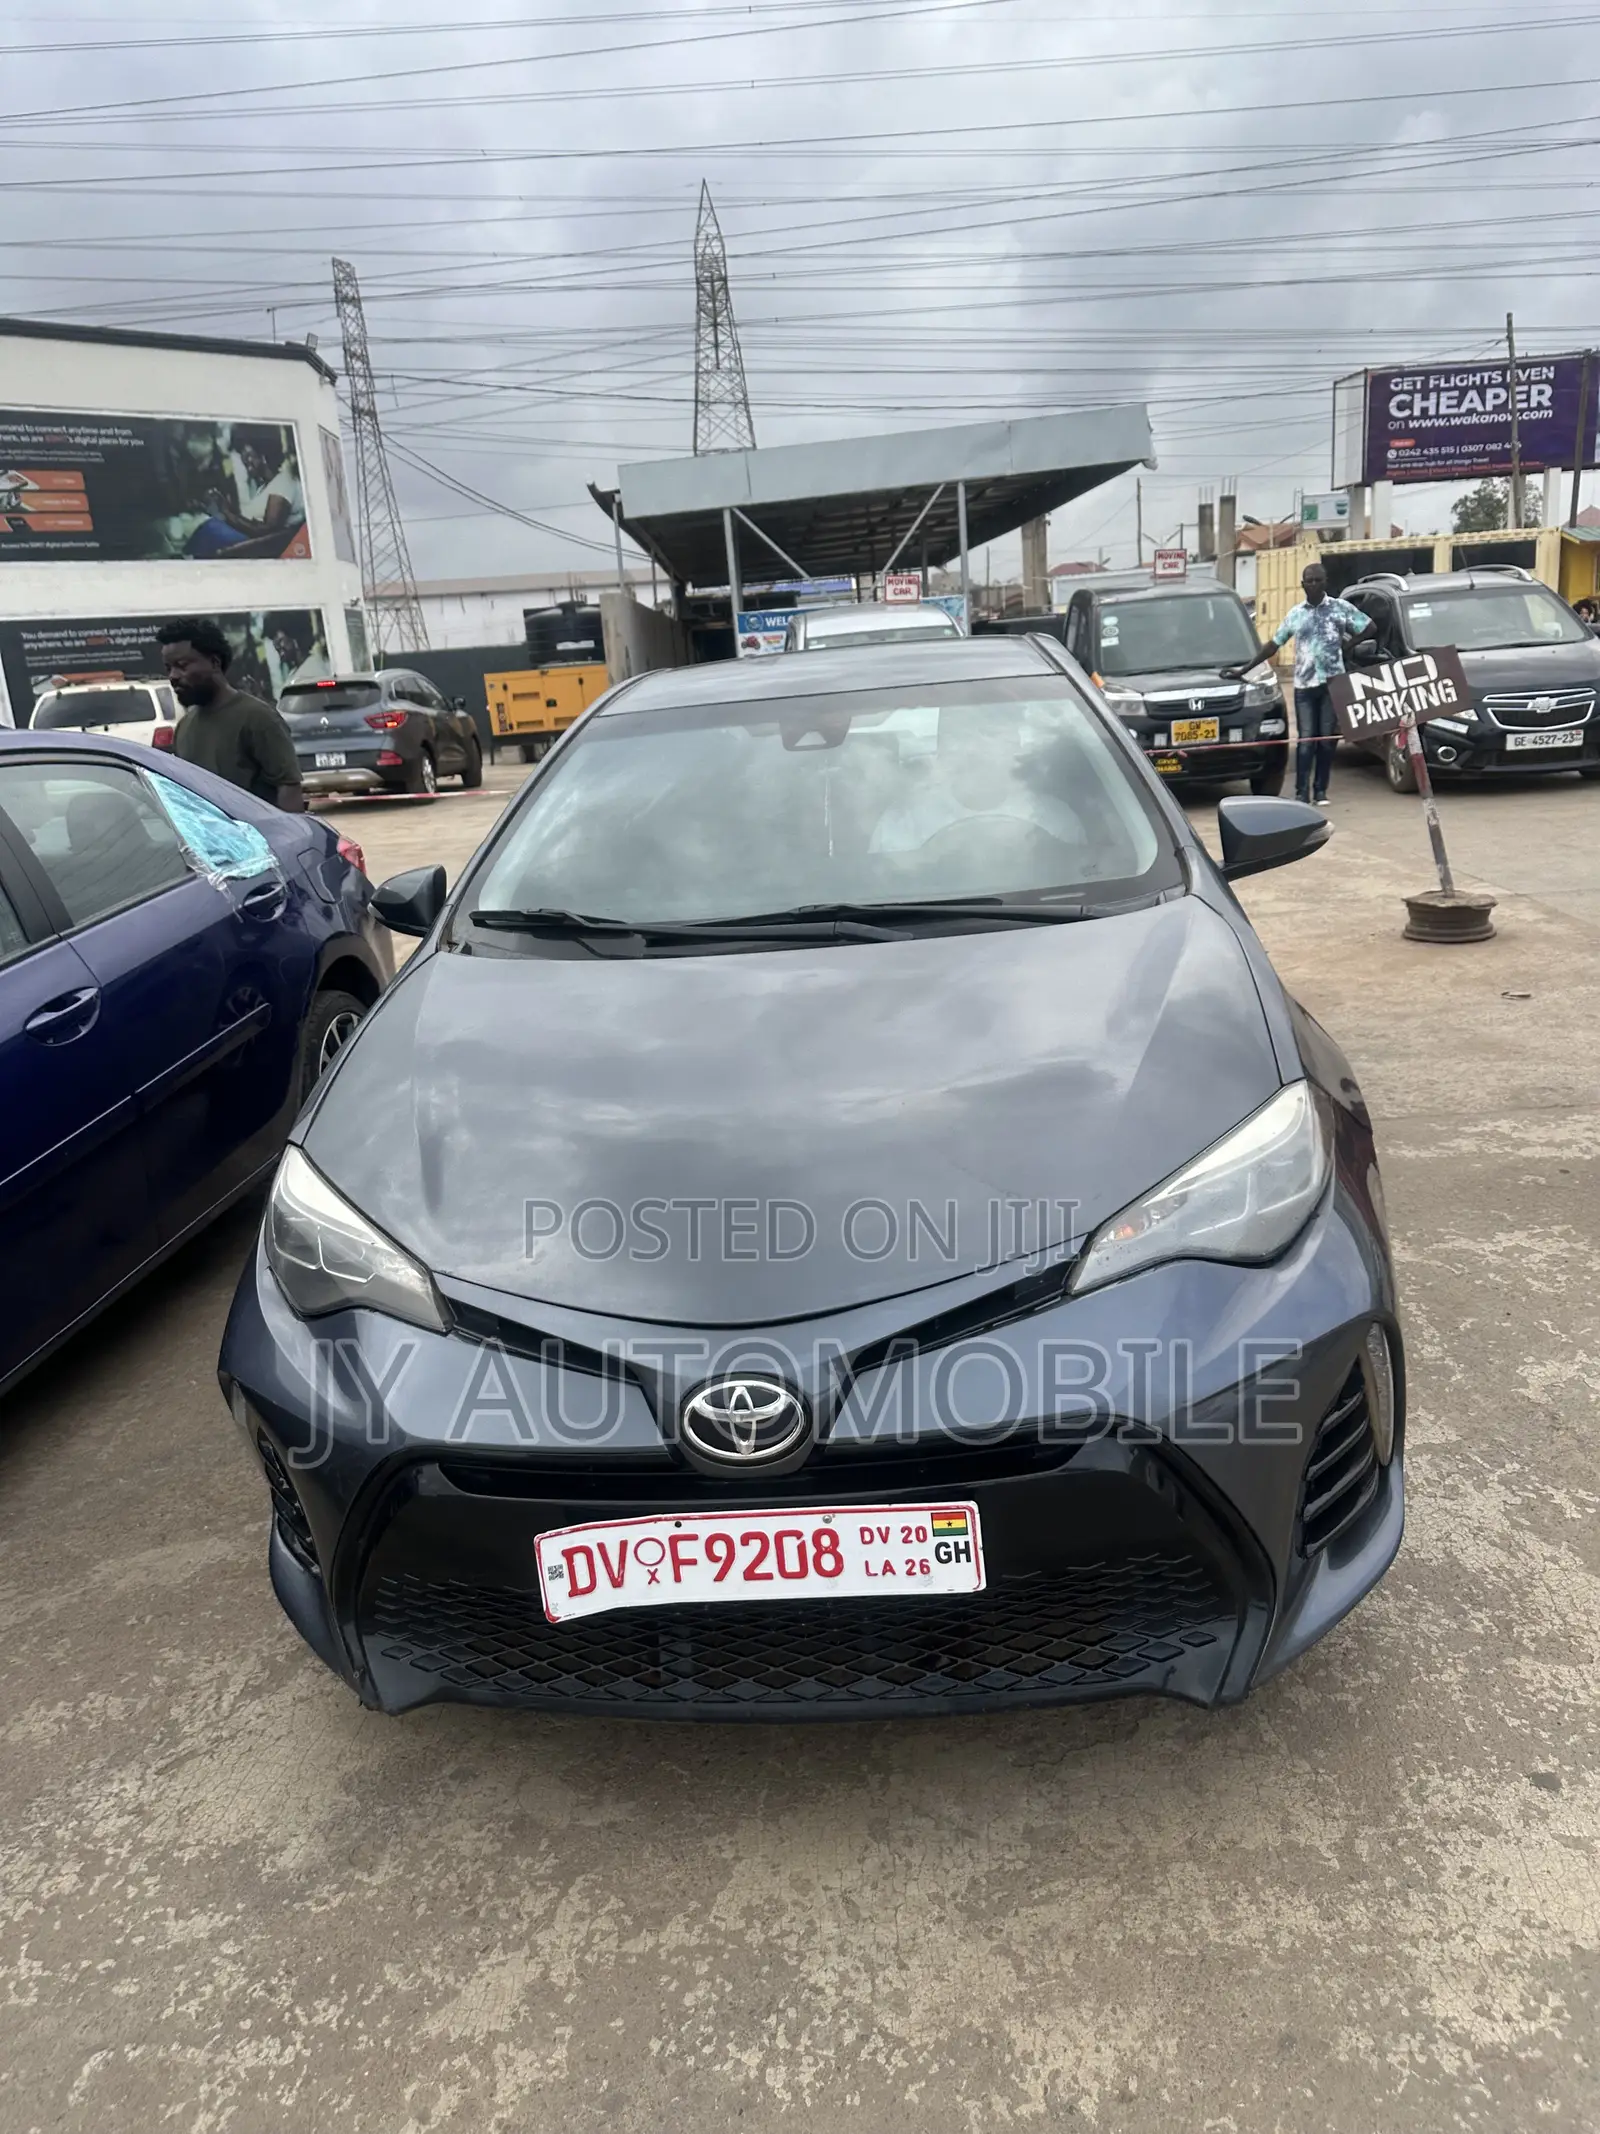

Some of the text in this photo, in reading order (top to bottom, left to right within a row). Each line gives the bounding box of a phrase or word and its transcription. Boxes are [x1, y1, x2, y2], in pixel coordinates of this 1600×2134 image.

[1390, 376, 1425, 391] GET
[1429, 371, 1502, 389] FLIGHTS
[1388, 383, 1553, 418] CHEAPER
[1388, 420, 1405, 430] on
[887, 577, 918, 586] MOVING
[893, 587, 913, 596] CAR
[1349, 653, 1438, 701] NO
[1346, 678, 1459, 729] PARKING
[1514, 736, 1527, 747] GE
[1532, 732, 1575, 745] 4527-23
[859, 1525, 928, 1545] DV 20
[668, 1527, 844, 1583] F9208
[934, 1540, 972, 1564] GH
[561, 1540, 628, 1598] DV
[864, 1558, 931, 1577] LA 26
